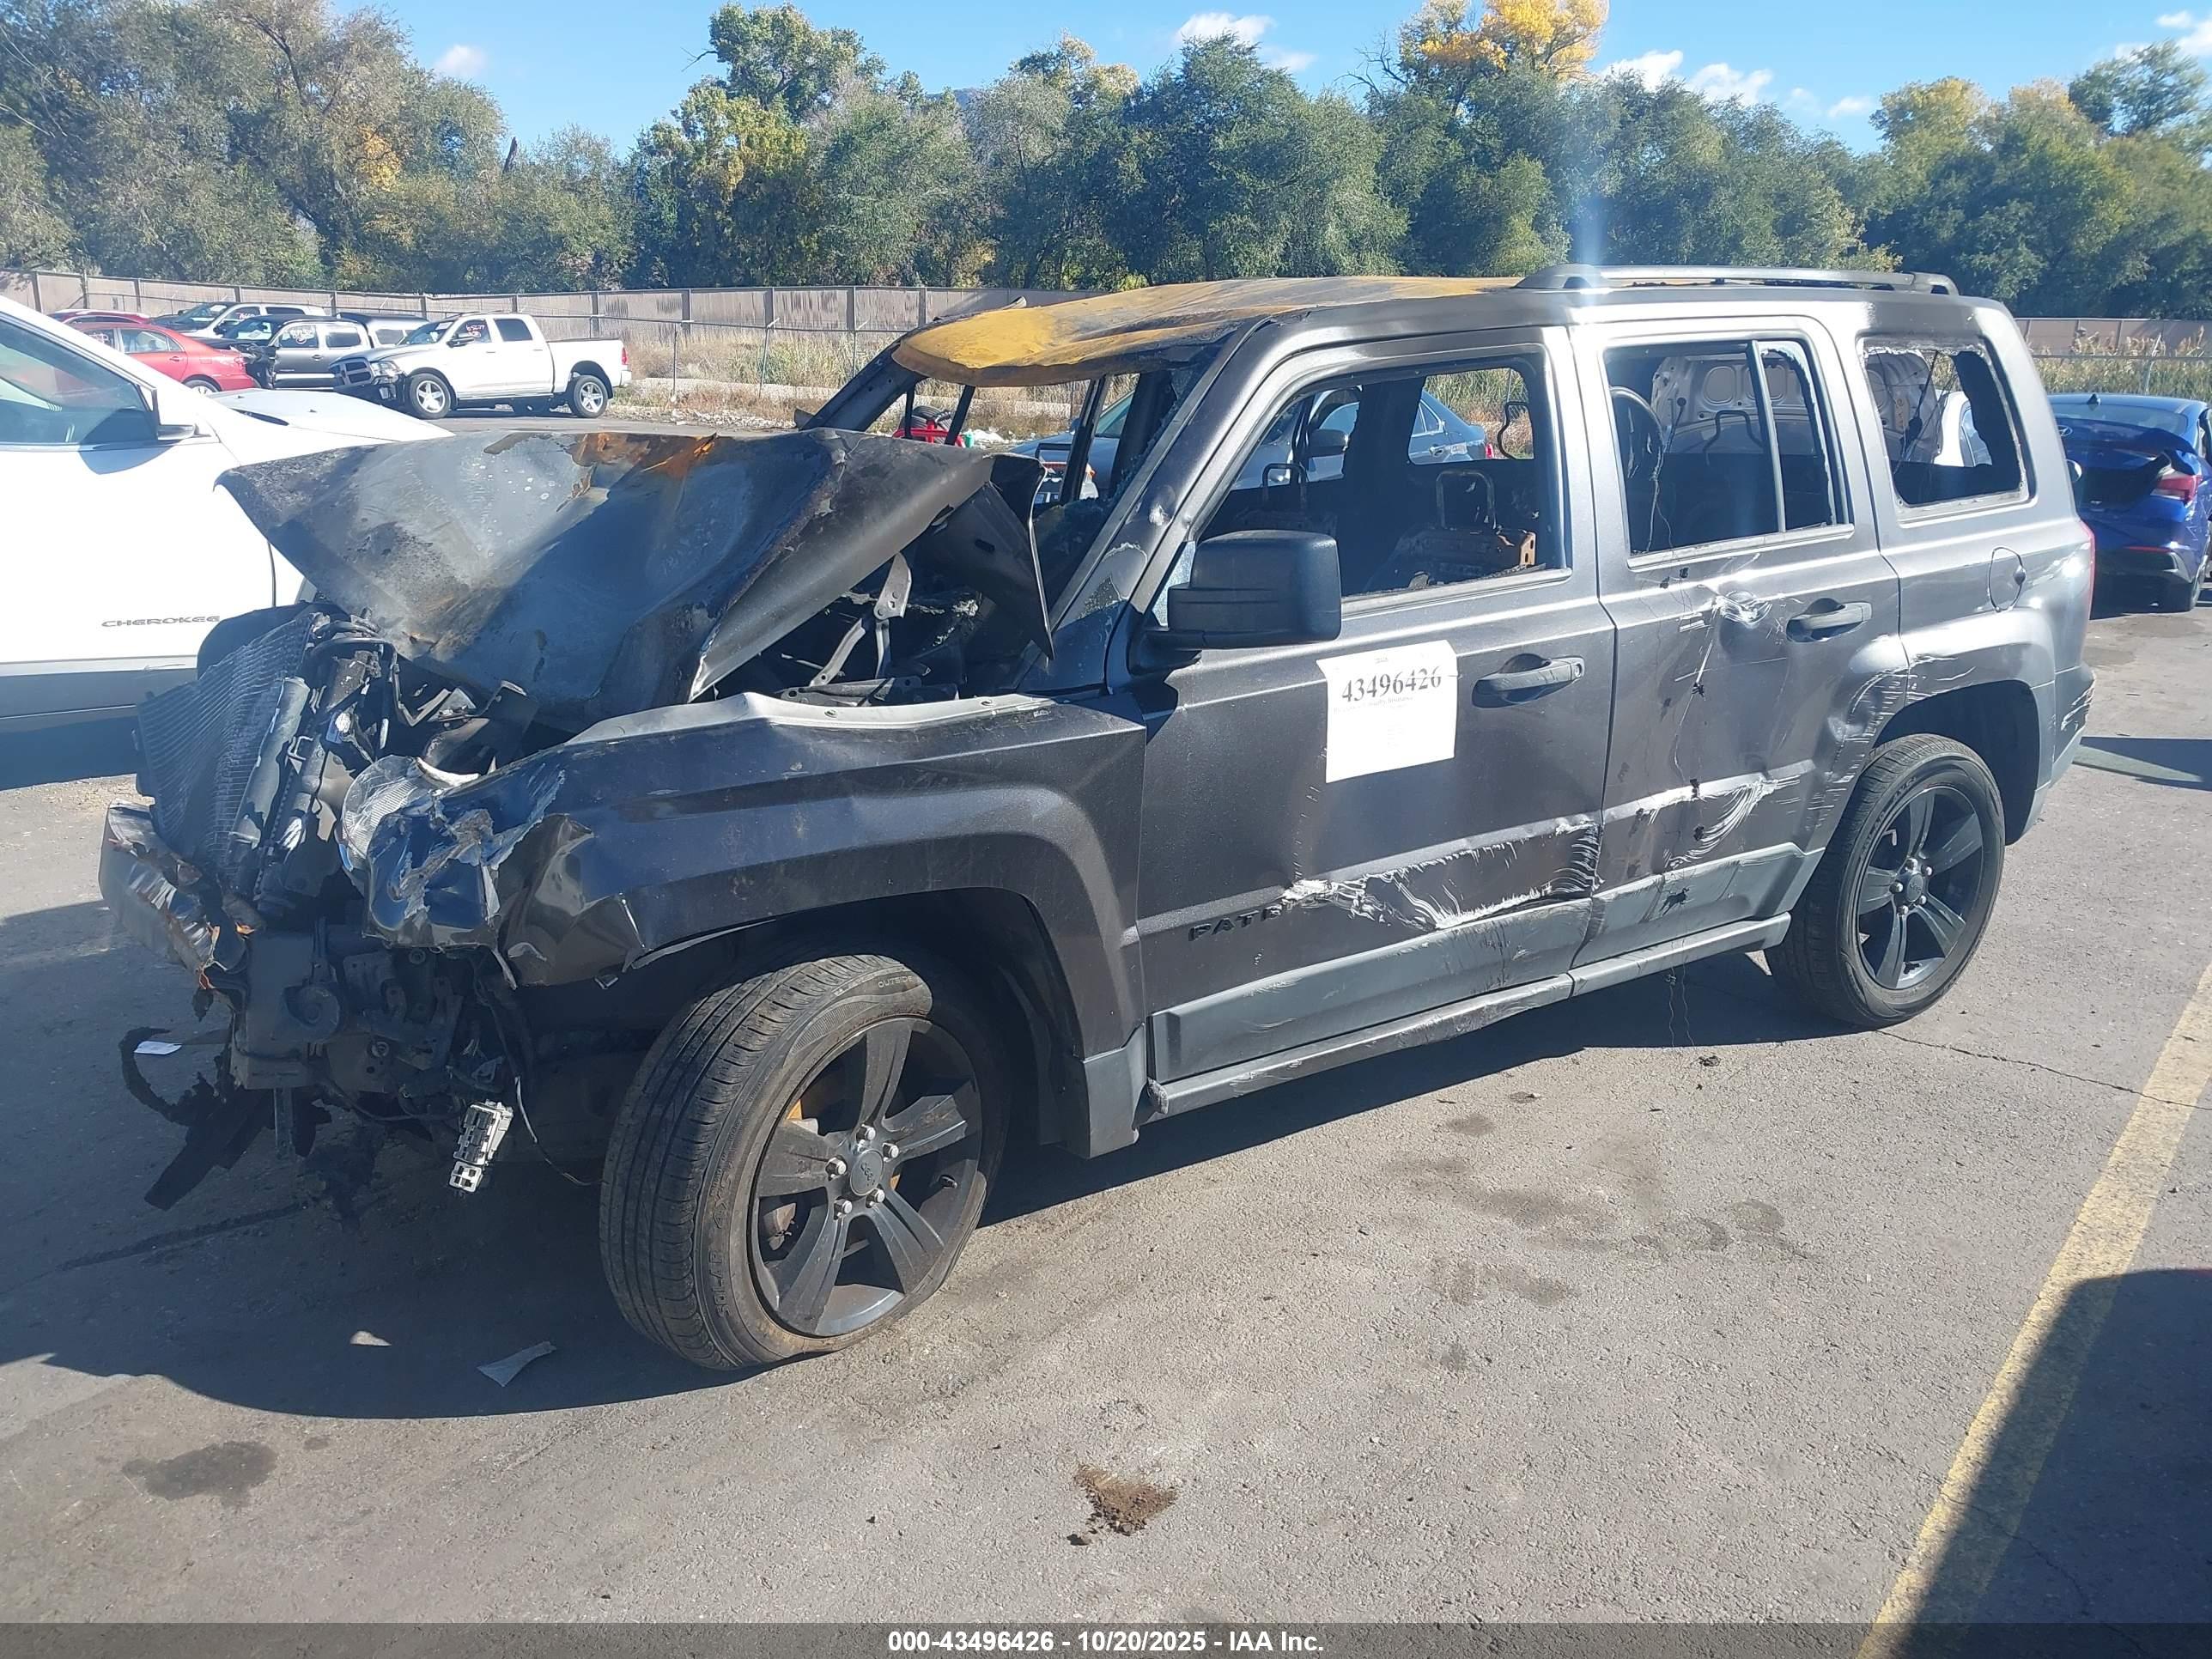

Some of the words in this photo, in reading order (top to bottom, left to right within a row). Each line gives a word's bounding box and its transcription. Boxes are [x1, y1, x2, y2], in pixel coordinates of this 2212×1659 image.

[101, 616, 220, 627] CHEROKEE
[1341, 665, 1442, 702] 43496426
[878, 975, 914, 988] OUTSIDE
